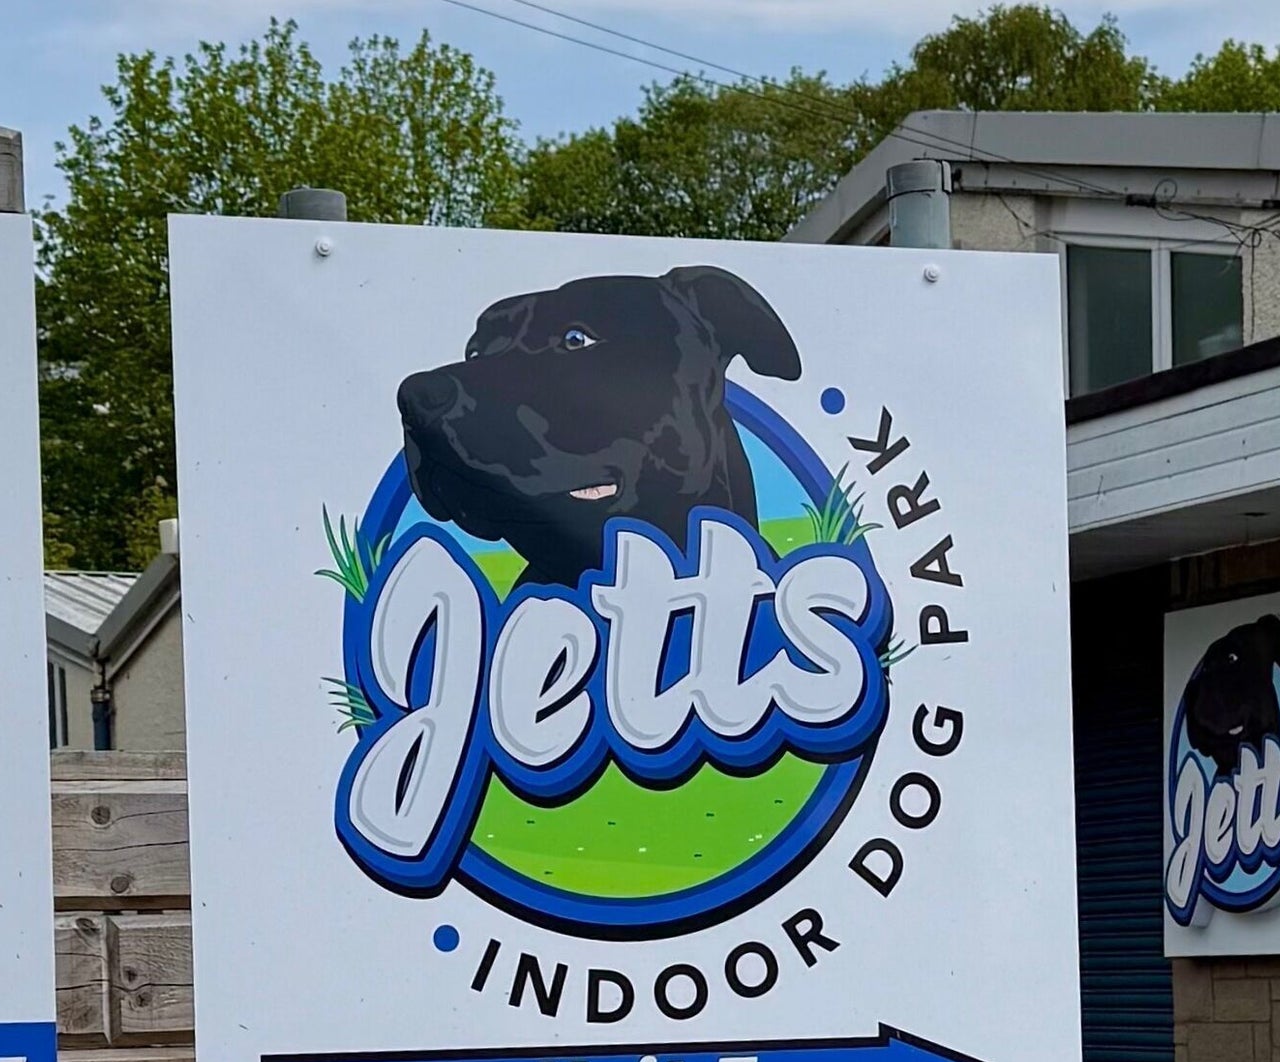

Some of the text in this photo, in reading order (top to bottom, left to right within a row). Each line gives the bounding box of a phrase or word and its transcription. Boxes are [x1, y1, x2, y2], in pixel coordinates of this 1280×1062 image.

[354, 520, 867, 858] Jetts
[470, 405, 969, 1025] INDOOR DOG PARK
